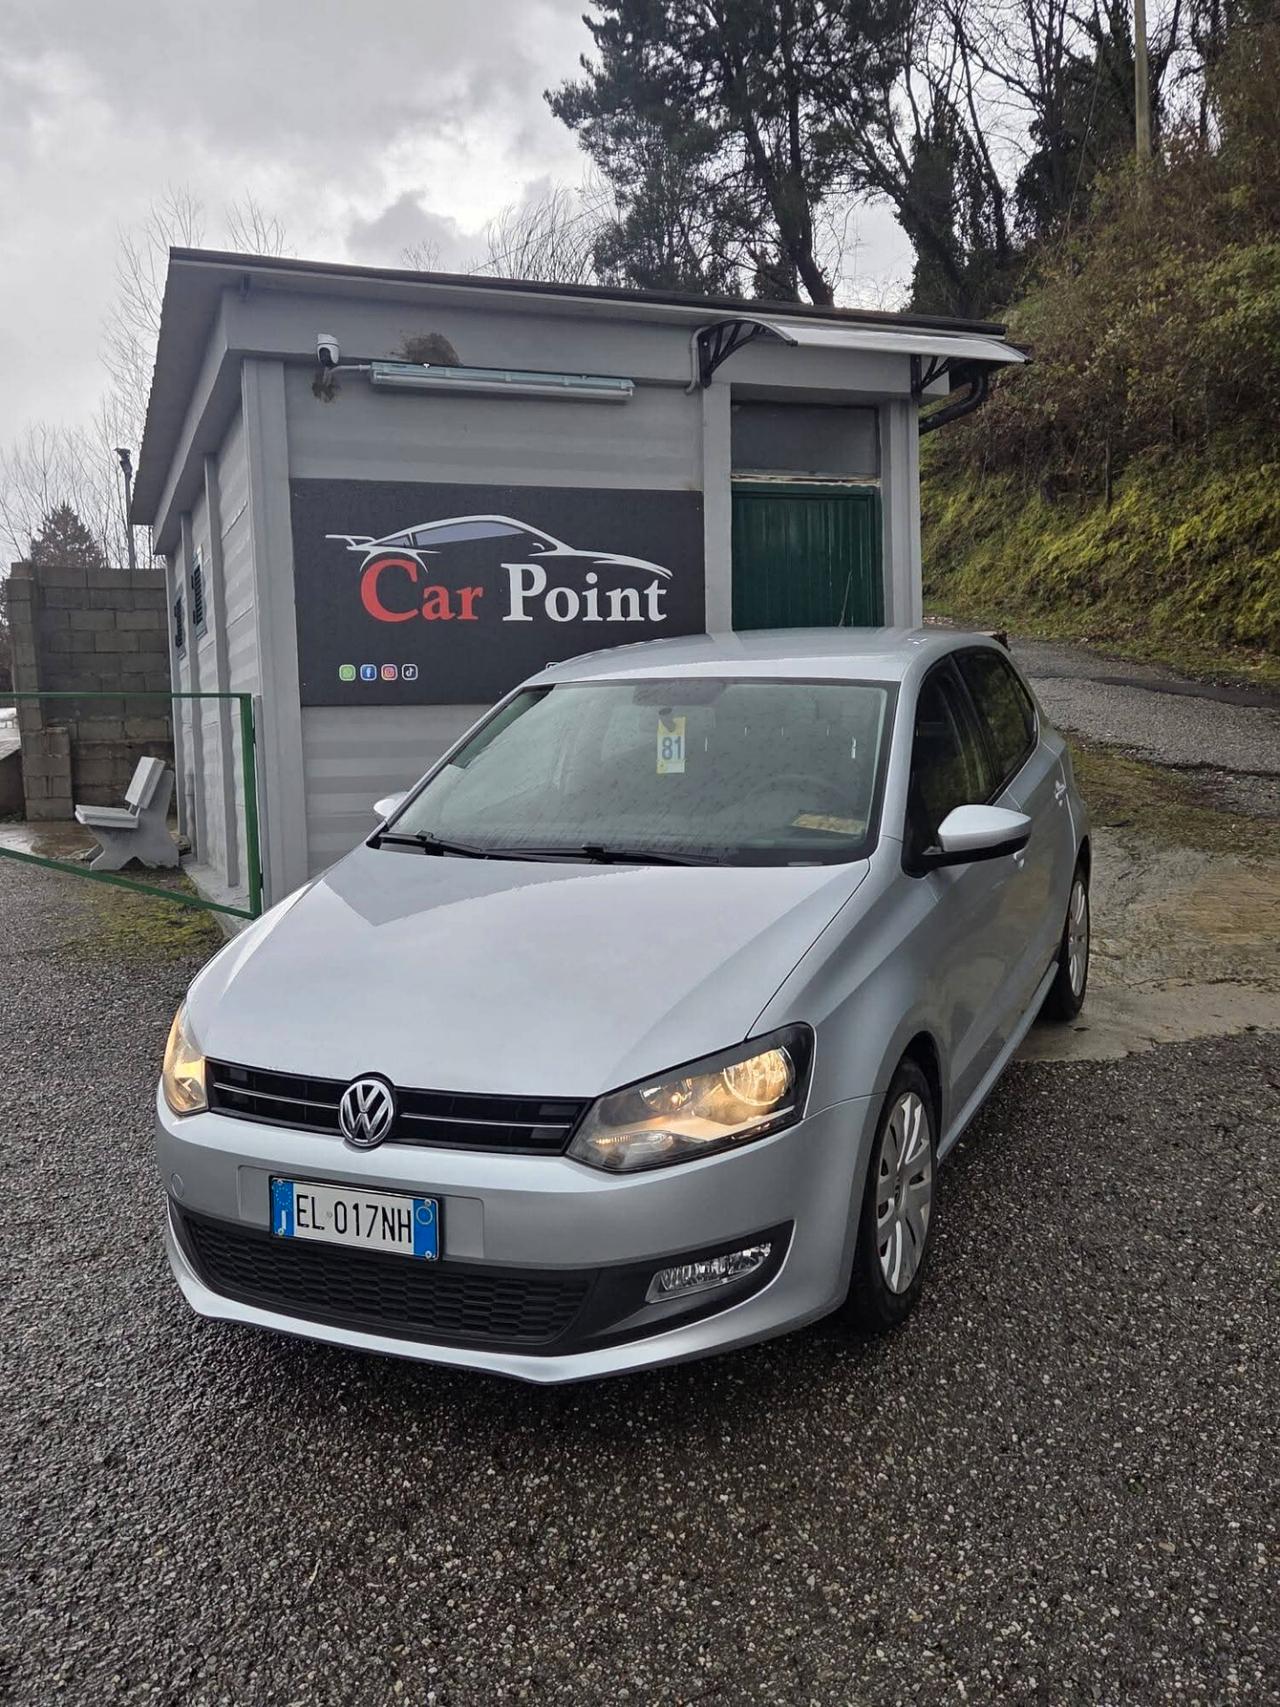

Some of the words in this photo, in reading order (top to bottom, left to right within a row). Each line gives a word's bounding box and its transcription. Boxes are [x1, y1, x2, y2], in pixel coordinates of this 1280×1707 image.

[360, 559, 484, 622] Car
[501, 562, 668, 622] Point
[662, 736, 681, 760] 81
[296, 1194, 325, 1230] EL
[334, 1201, 412, 1243] 017NH
